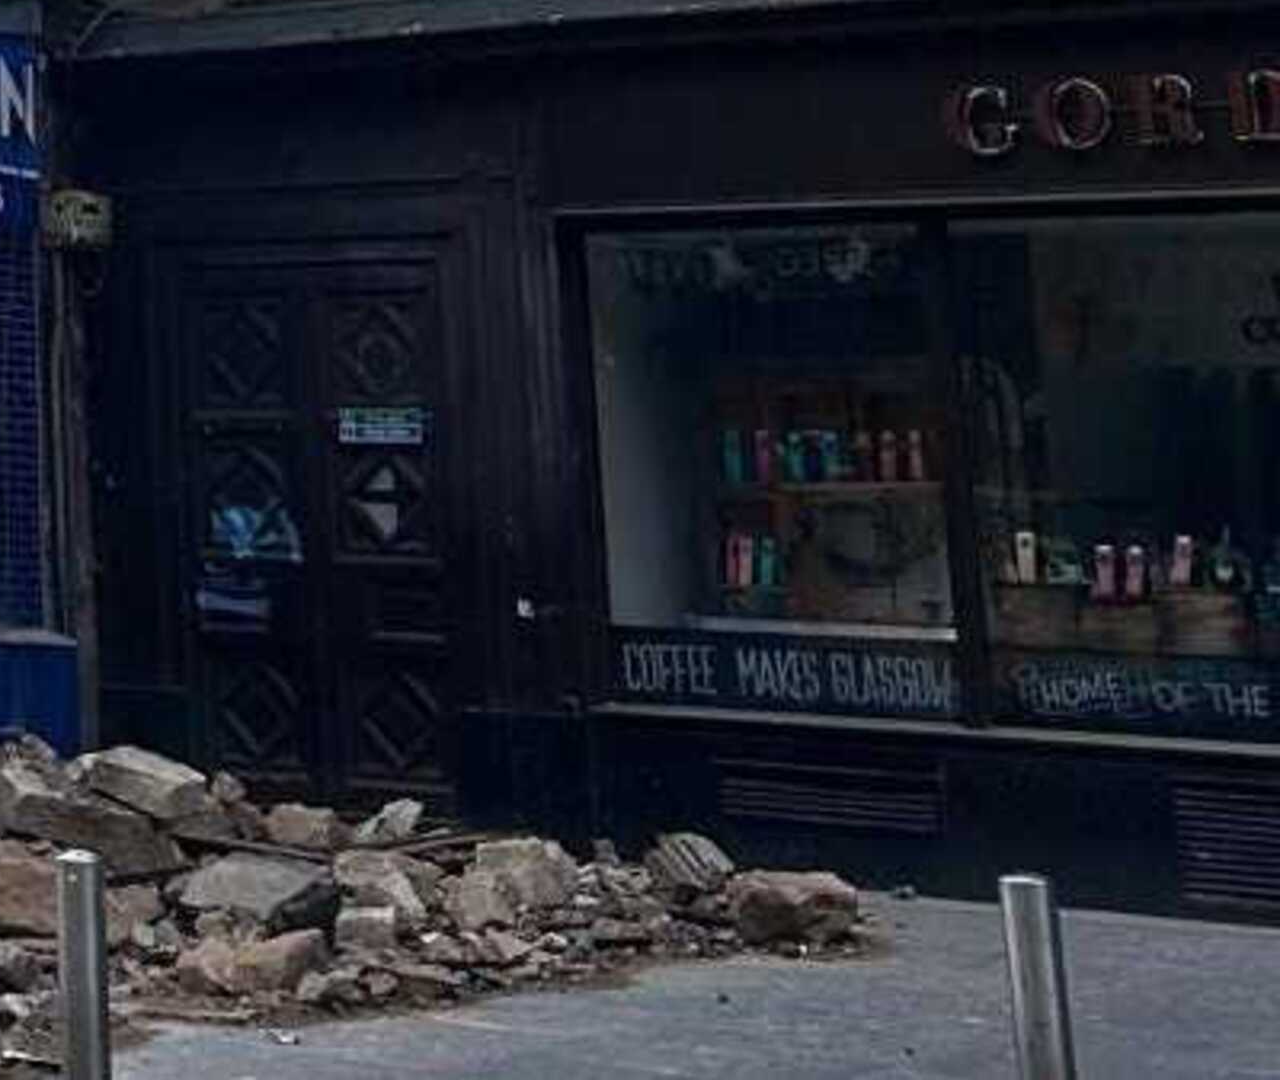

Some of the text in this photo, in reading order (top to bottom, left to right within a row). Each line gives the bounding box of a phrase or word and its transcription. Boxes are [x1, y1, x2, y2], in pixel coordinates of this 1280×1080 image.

[623, 641, 953, 713] COFFEE MAKES GLASGOW
[1151, 681, 1192, 713] OF
[1201, 682, 1272, 718] THE
